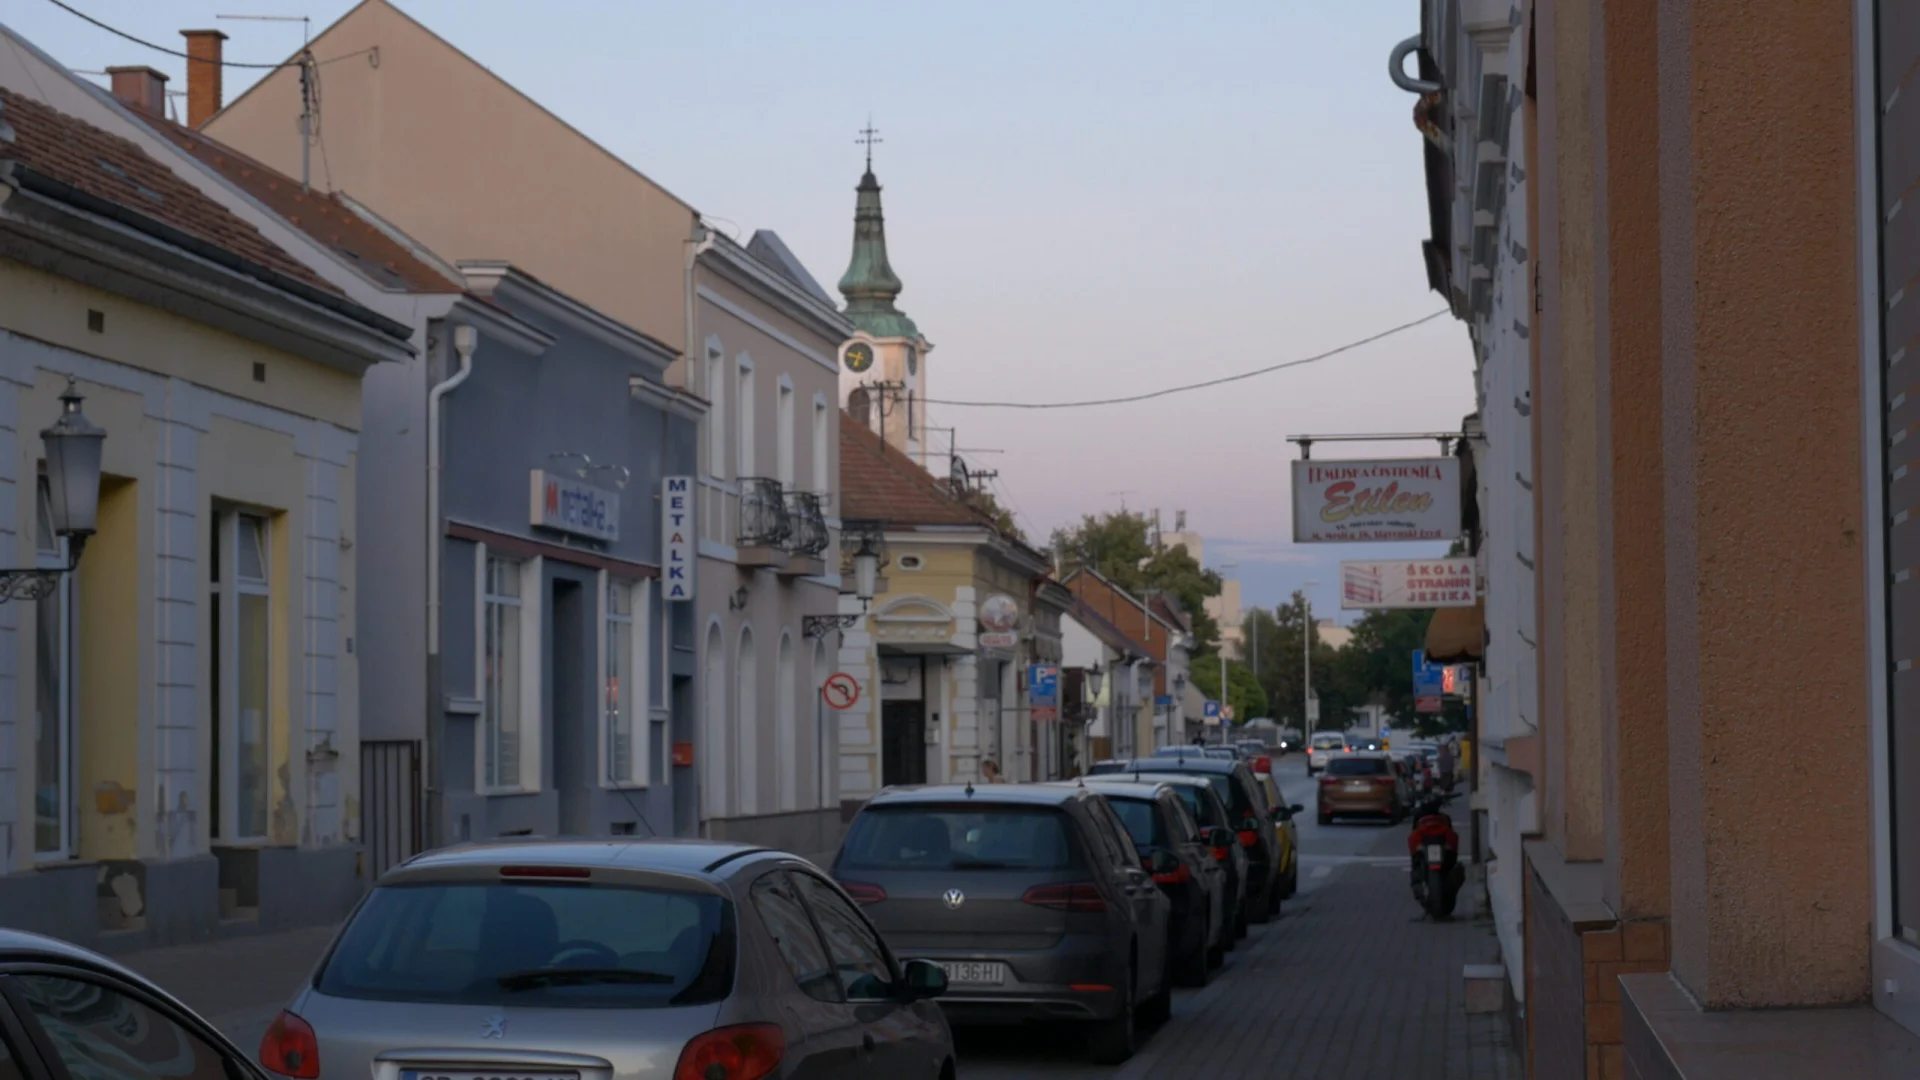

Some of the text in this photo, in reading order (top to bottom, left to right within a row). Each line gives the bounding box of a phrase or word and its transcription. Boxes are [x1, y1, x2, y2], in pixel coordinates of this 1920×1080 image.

[1320, 481, 1434, 523] Etilen
[668, 479, 686, 597] METALKA
[1406, 563, 1471, 576] ŠKOLA
[1406, 578, 1471, 590] STRANIH
[1406, 590, 1471, 602] JEZIKA
